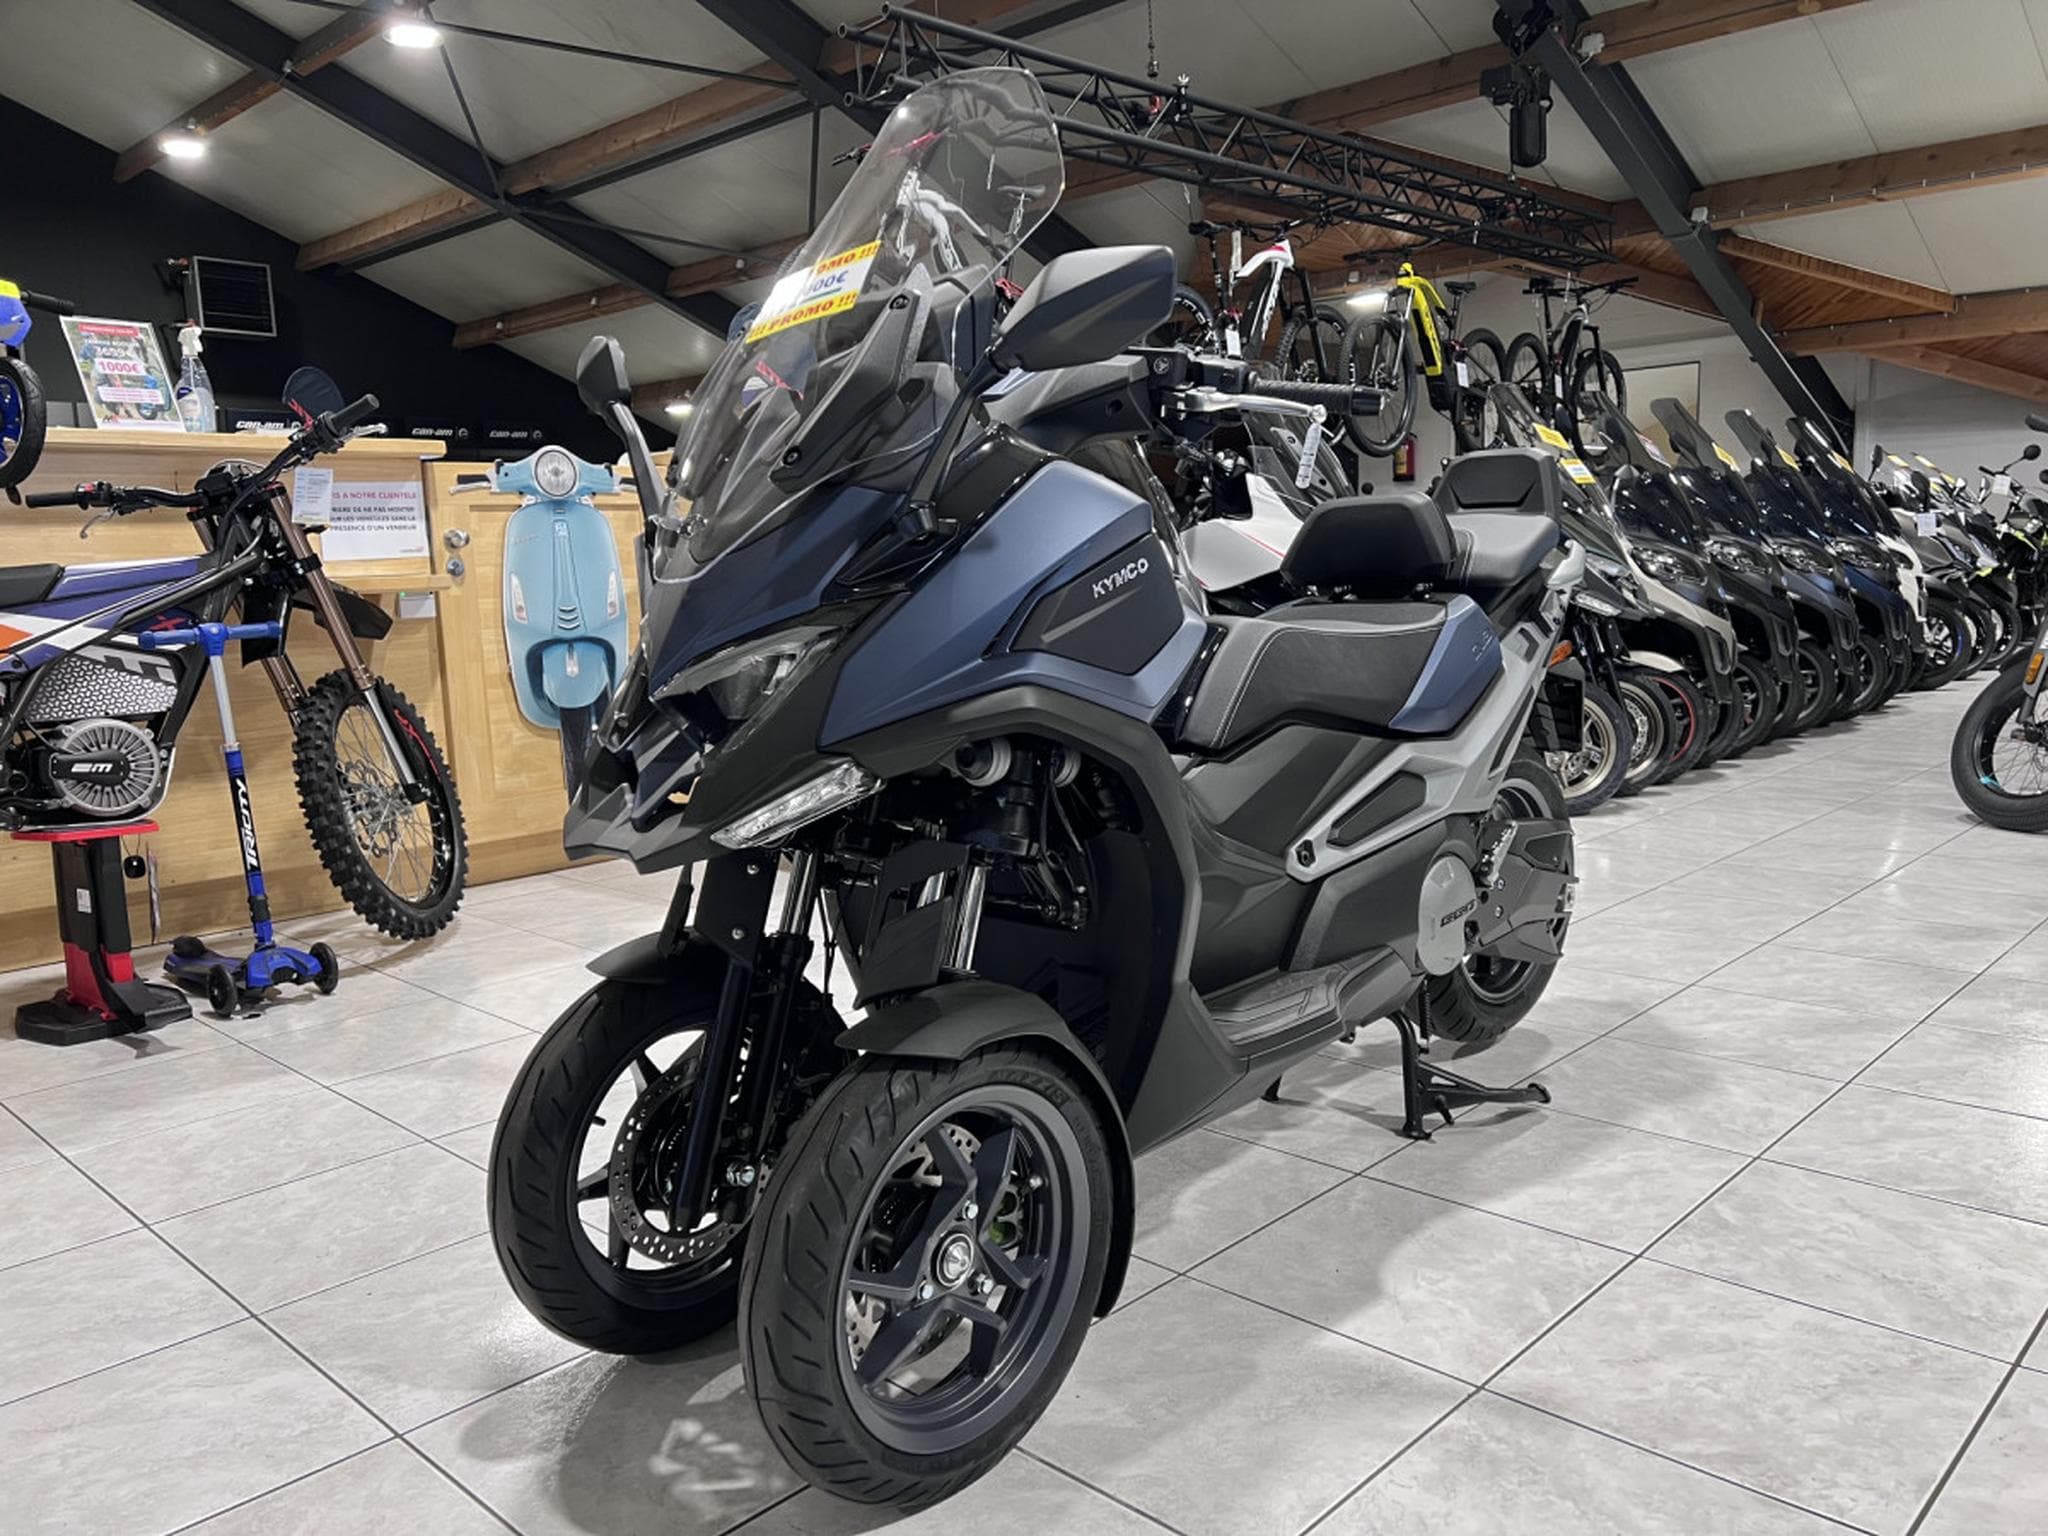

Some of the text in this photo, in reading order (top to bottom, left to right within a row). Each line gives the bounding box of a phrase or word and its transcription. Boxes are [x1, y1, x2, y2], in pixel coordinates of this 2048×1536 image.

[767, 299, 835, 332] PROMO
[98, 360, 140, 373] 1000€
[350, 491, 377, 500] NOTRE
[1091, 557, 1150, 600] KYMCO
[236, 778, 259, 872] TRICITY
